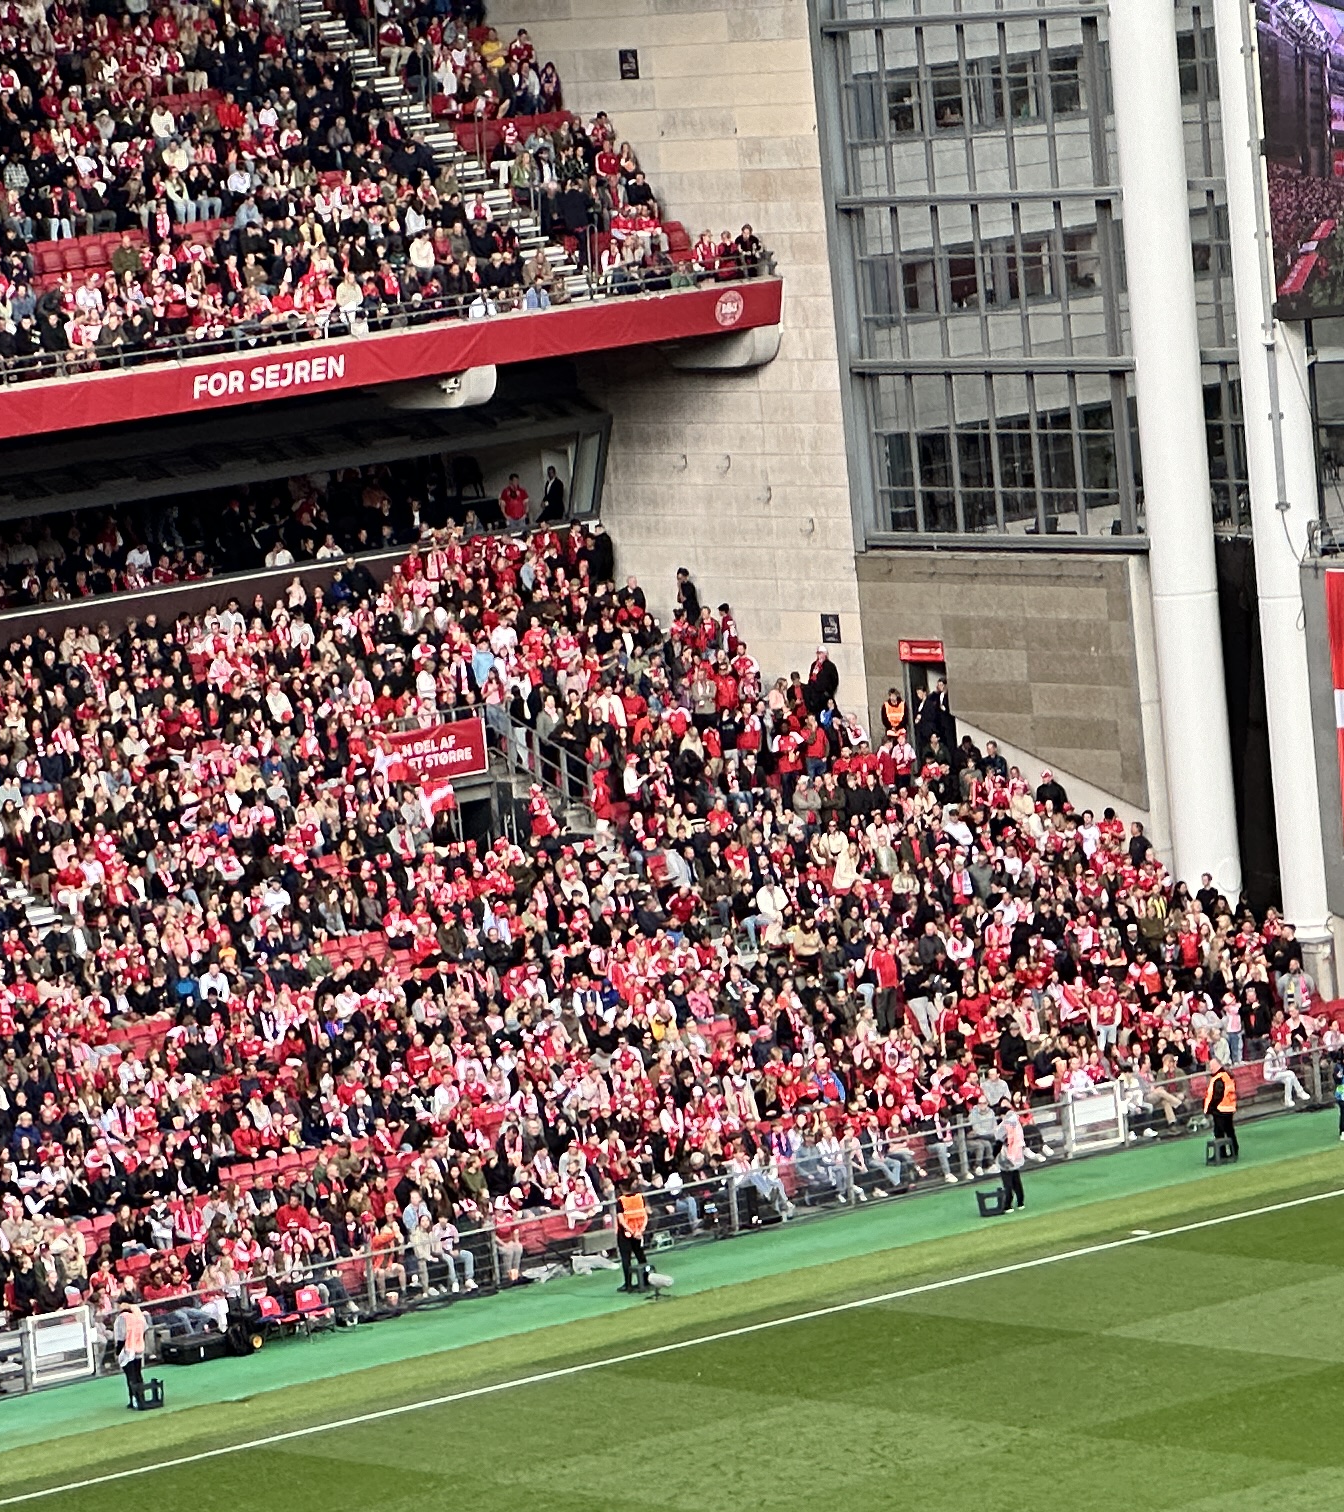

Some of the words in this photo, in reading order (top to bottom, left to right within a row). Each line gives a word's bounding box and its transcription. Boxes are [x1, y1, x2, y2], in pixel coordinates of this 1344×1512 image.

[193, 369, 245, 400] FOR
[249, 354, 345, 392] SEJREN
[413, 738, 439, 755] DEL
[440, 734, 456, 750] AF
